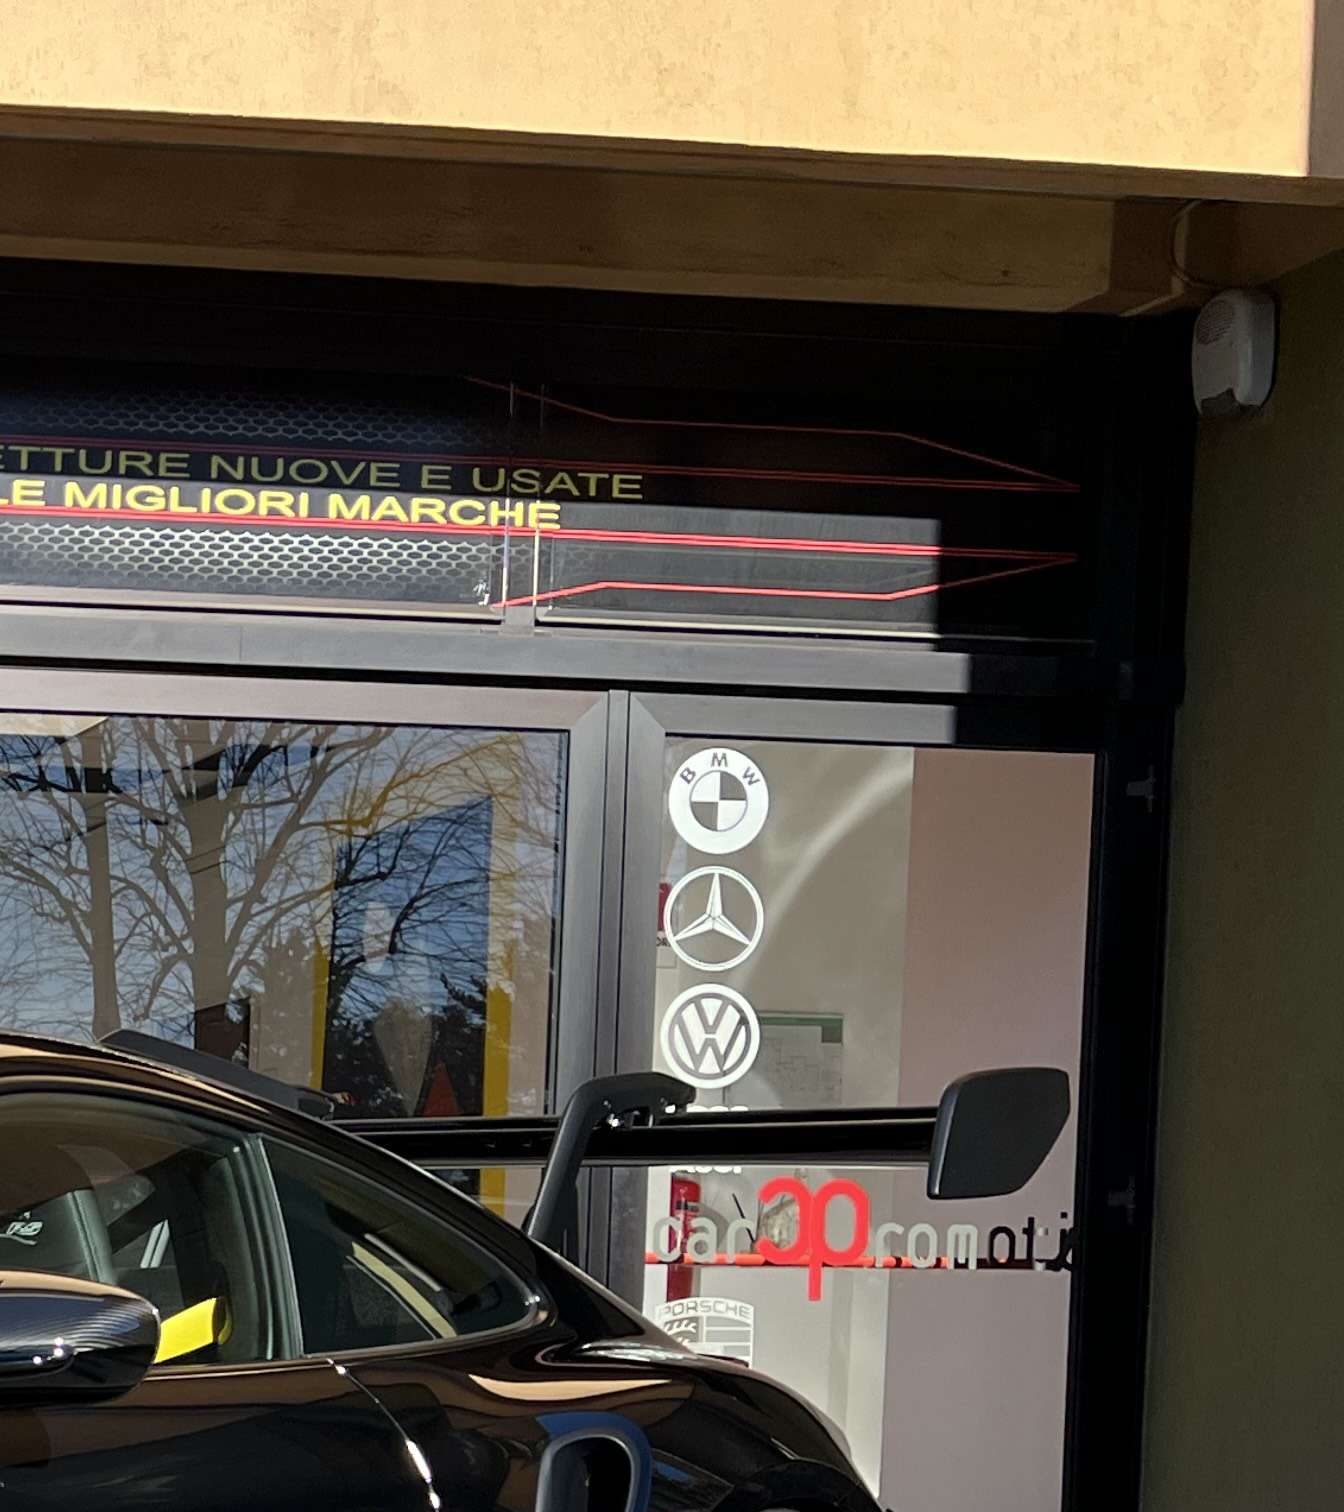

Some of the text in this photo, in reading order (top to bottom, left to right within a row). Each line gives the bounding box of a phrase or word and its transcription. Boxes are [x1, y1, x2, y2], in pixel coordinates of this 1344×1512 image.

[210, 454, 399, 490] NUOVE
[421, 464, 452, 493] E
[473, 467, 644, 501] USATE
[65, 481, 310, 519] MIGLIORI
[329, 492, 562, 530] MARCHE
[679, 751, 762, 787] BMW
[658, 1300, 750, 1319] PORSCHE
